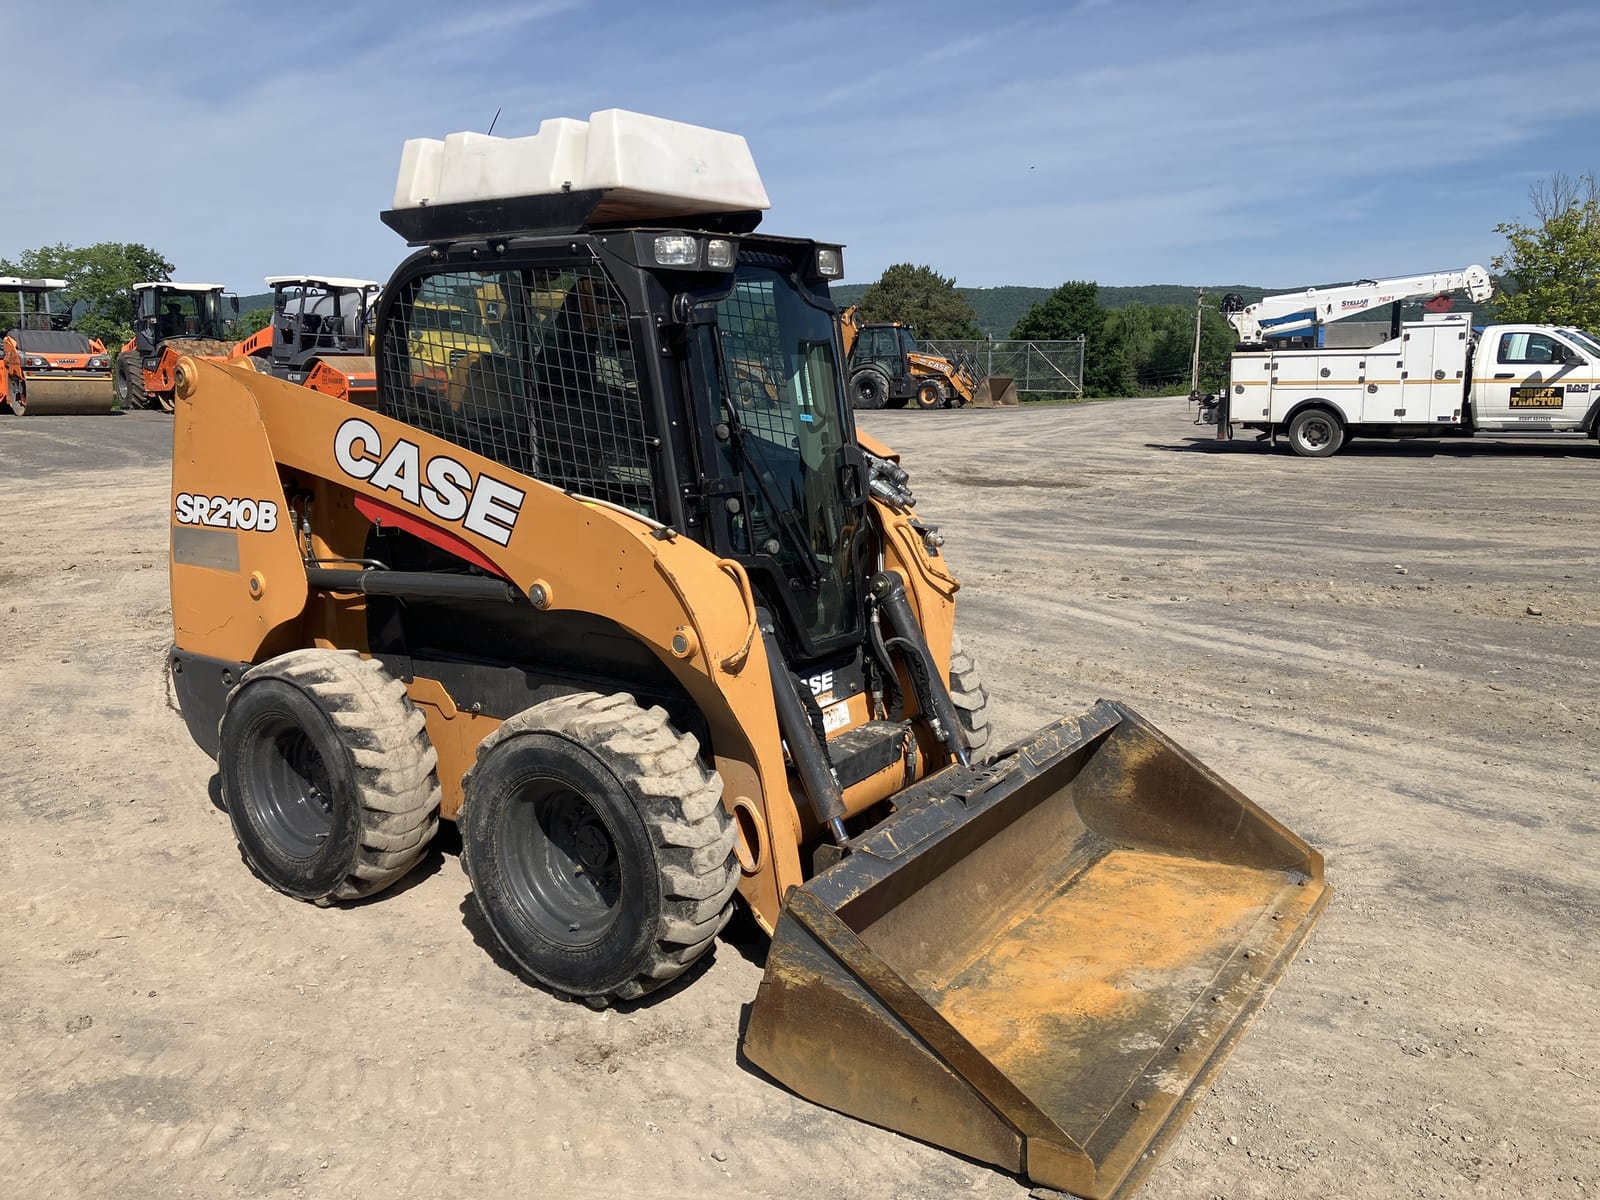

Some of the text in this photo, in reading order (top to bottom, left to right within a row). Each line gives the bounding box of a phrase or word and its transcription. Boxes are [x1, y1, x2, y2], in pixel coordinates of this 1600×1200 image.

[928, 361, 951, 371] CASE
[1511, 397, 1562, 406] TRACTOR
[334, 417, 525, 548] CASE
[175, 492, 278, 533] SR210B
